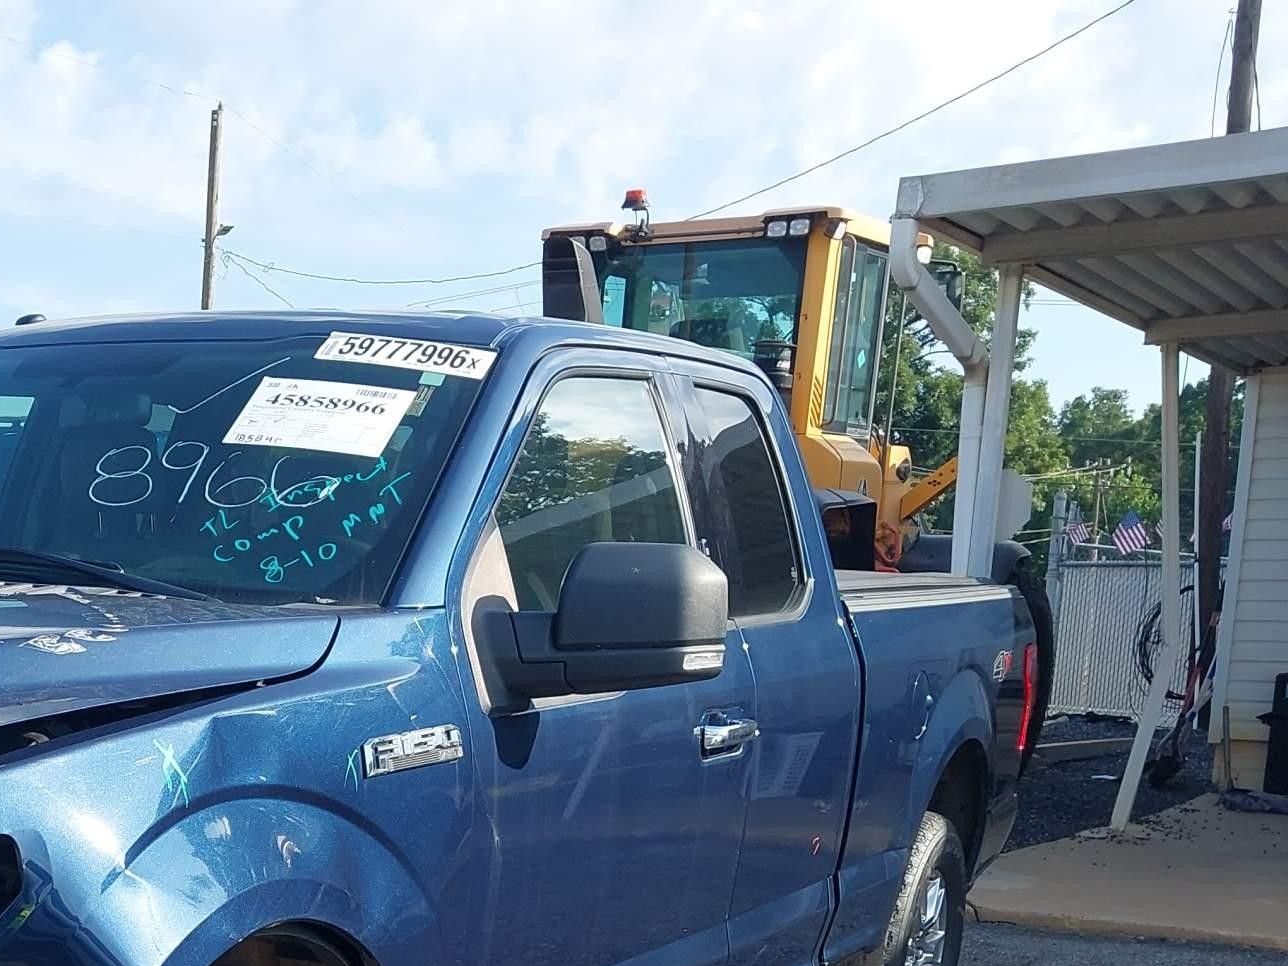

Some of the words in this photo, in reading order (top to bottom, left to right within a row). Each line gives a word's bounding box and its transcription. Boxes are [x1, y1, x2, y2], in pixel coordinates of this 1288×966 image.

[265, 393, 387, 415] 45858966
[89, 441, 340, 508] 8966
[259, 543, 337, 583] 8-10
